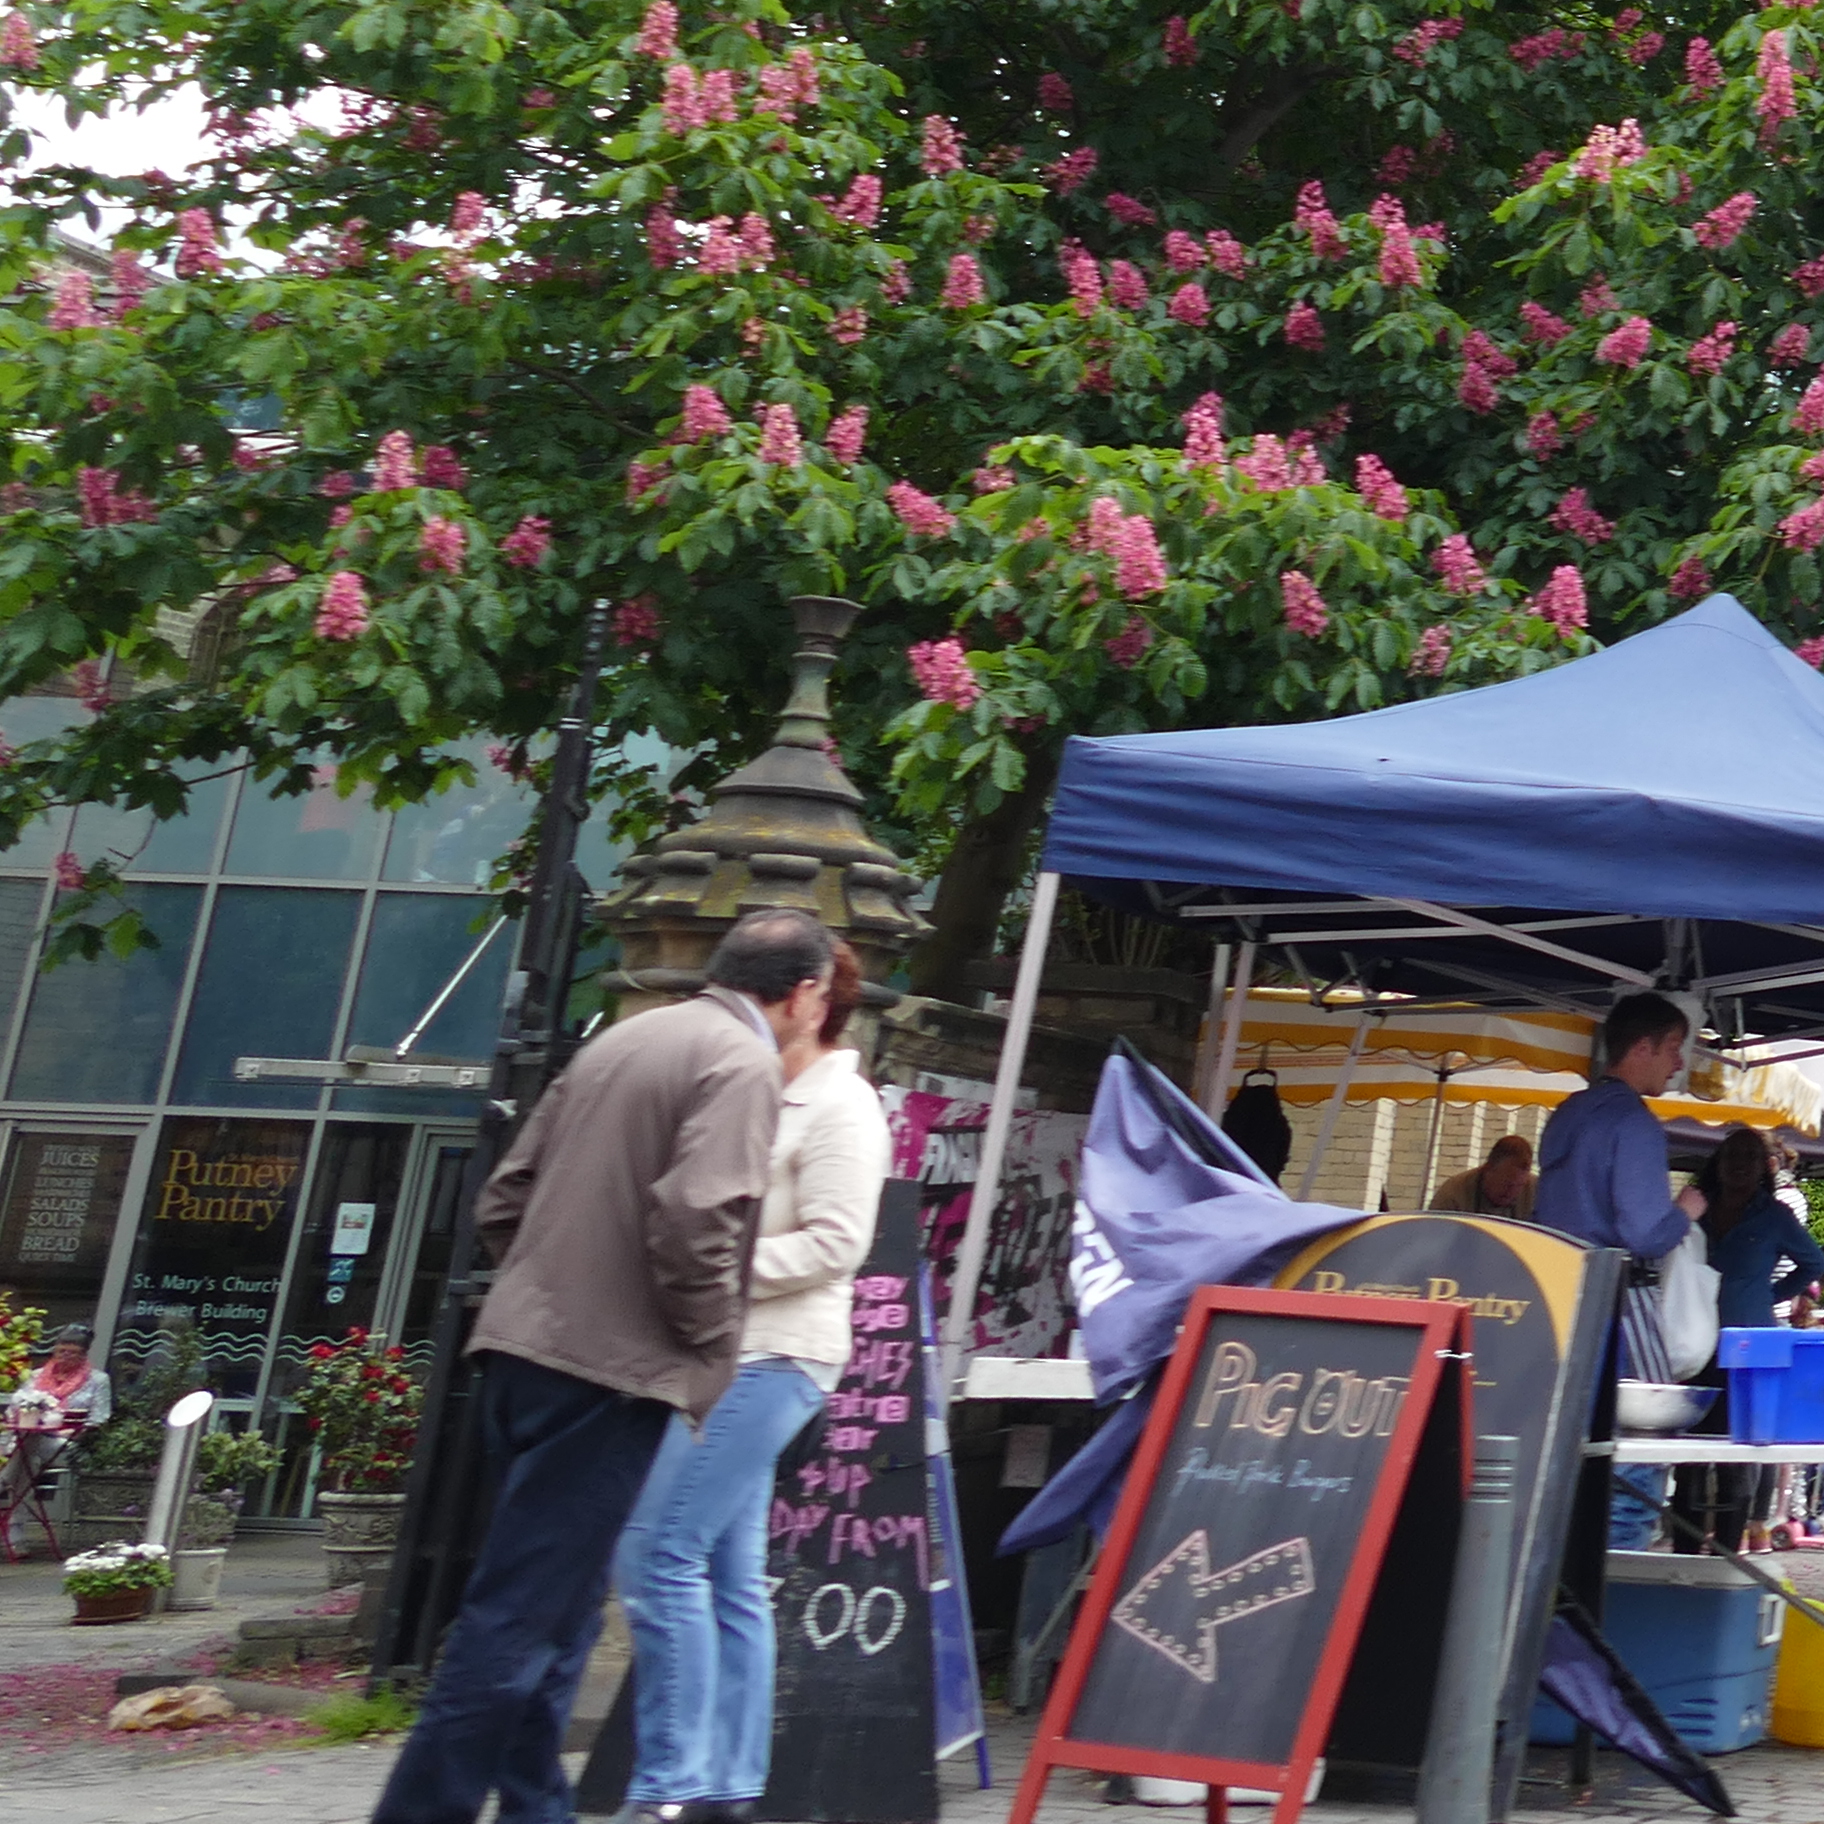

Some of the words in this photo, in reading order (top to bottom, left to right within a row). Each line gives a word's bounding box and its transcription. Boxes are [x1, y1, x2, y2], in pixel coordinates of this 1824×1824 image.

[41, 1151, 99, 1168] JUICES
[166, 1149, 298, 1197] Putney
[30, 1198, 91, 1211] SALADS
[154, 1184, 286, 1231] Pantry
[26, 1212, 88, 1228] SOUPS
[21, 1236, 81, 1251] BREAD
[132, 1273, 155, 1289] St.
[160, 1274, 217, 1294] Mary's
[222, 1276, 282, 1293] Church
[135, 1300, 196, 1318] Brewer
[201, 1303, 267, 1324] Building
[1300, 1367, 1413, 1438] OUT
[827, 1513, 932, 1592] FROM
